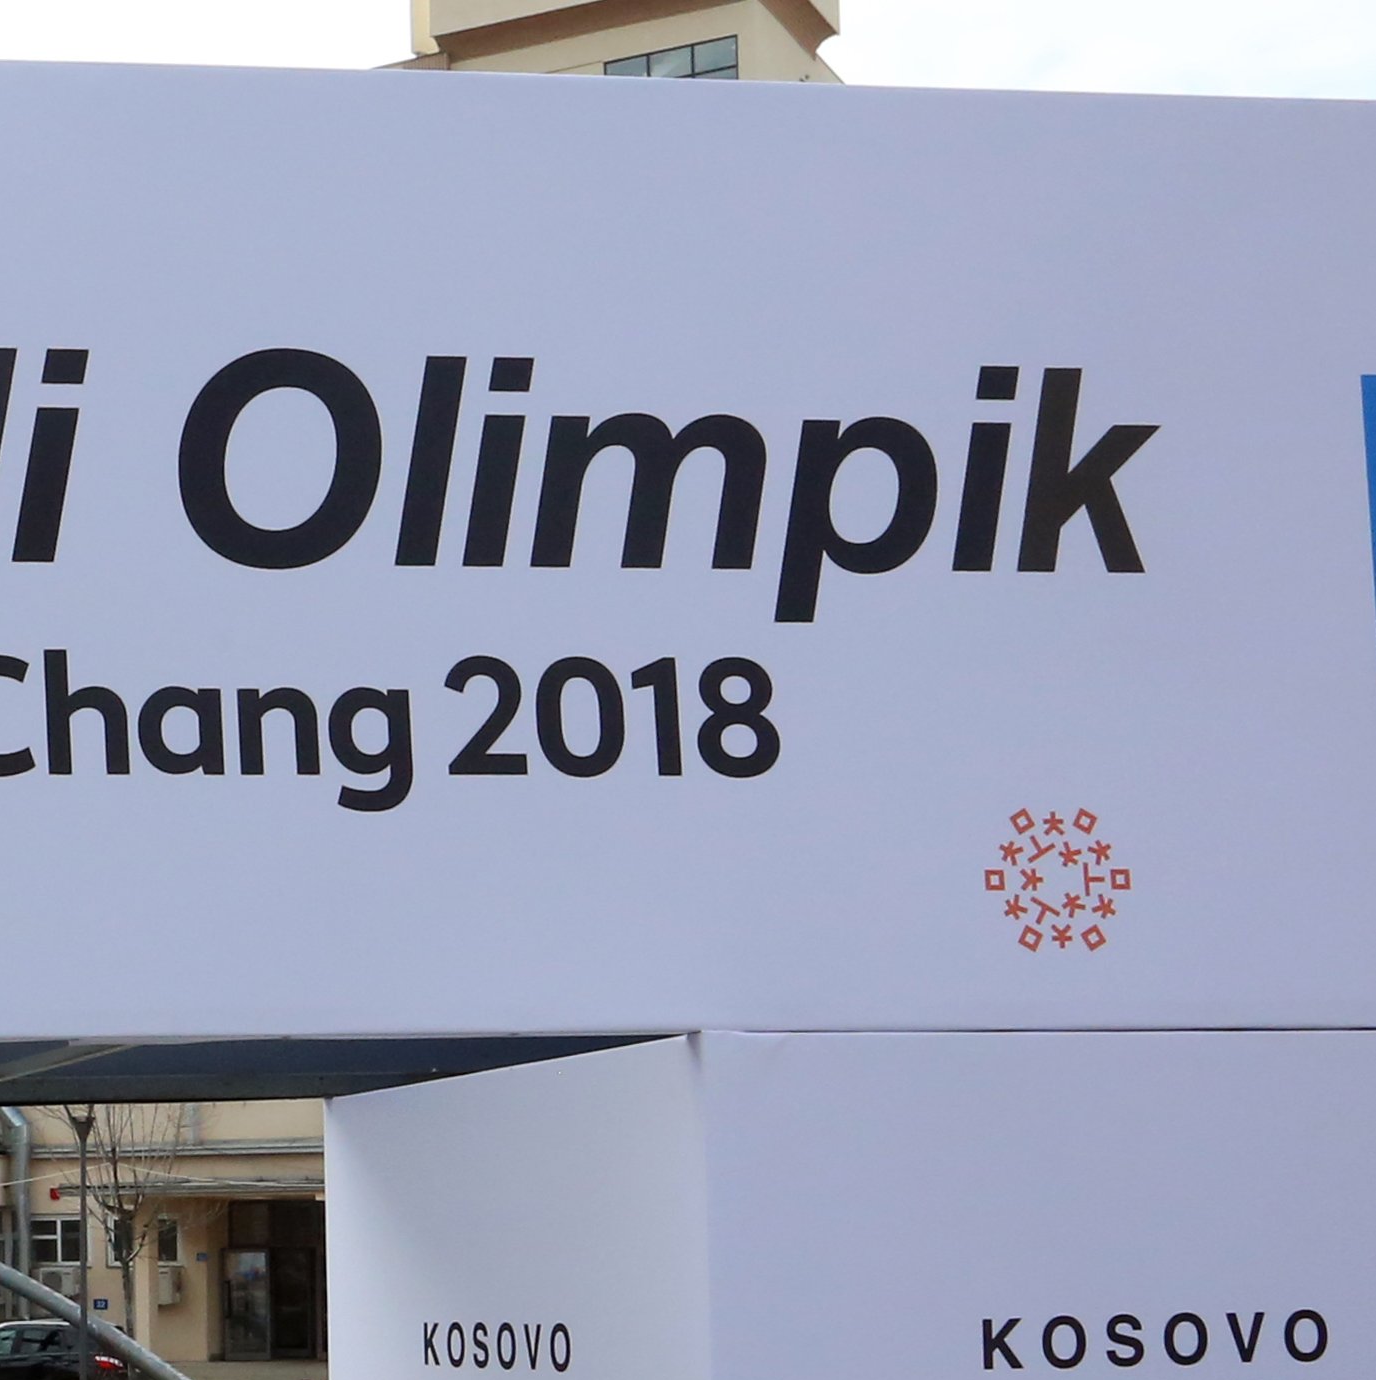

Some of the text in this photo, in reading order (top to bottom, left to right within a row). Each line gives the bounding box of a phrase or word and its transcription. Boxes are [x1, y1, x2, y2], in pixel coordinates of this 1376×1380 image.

[179, 349, 1160, 622] Olimpik
[446, 657, 780, 778] 2018
[423, 1321, 571, 1373] KOSOVO
[982, 1309, 1329, 1370] KOSOVO
